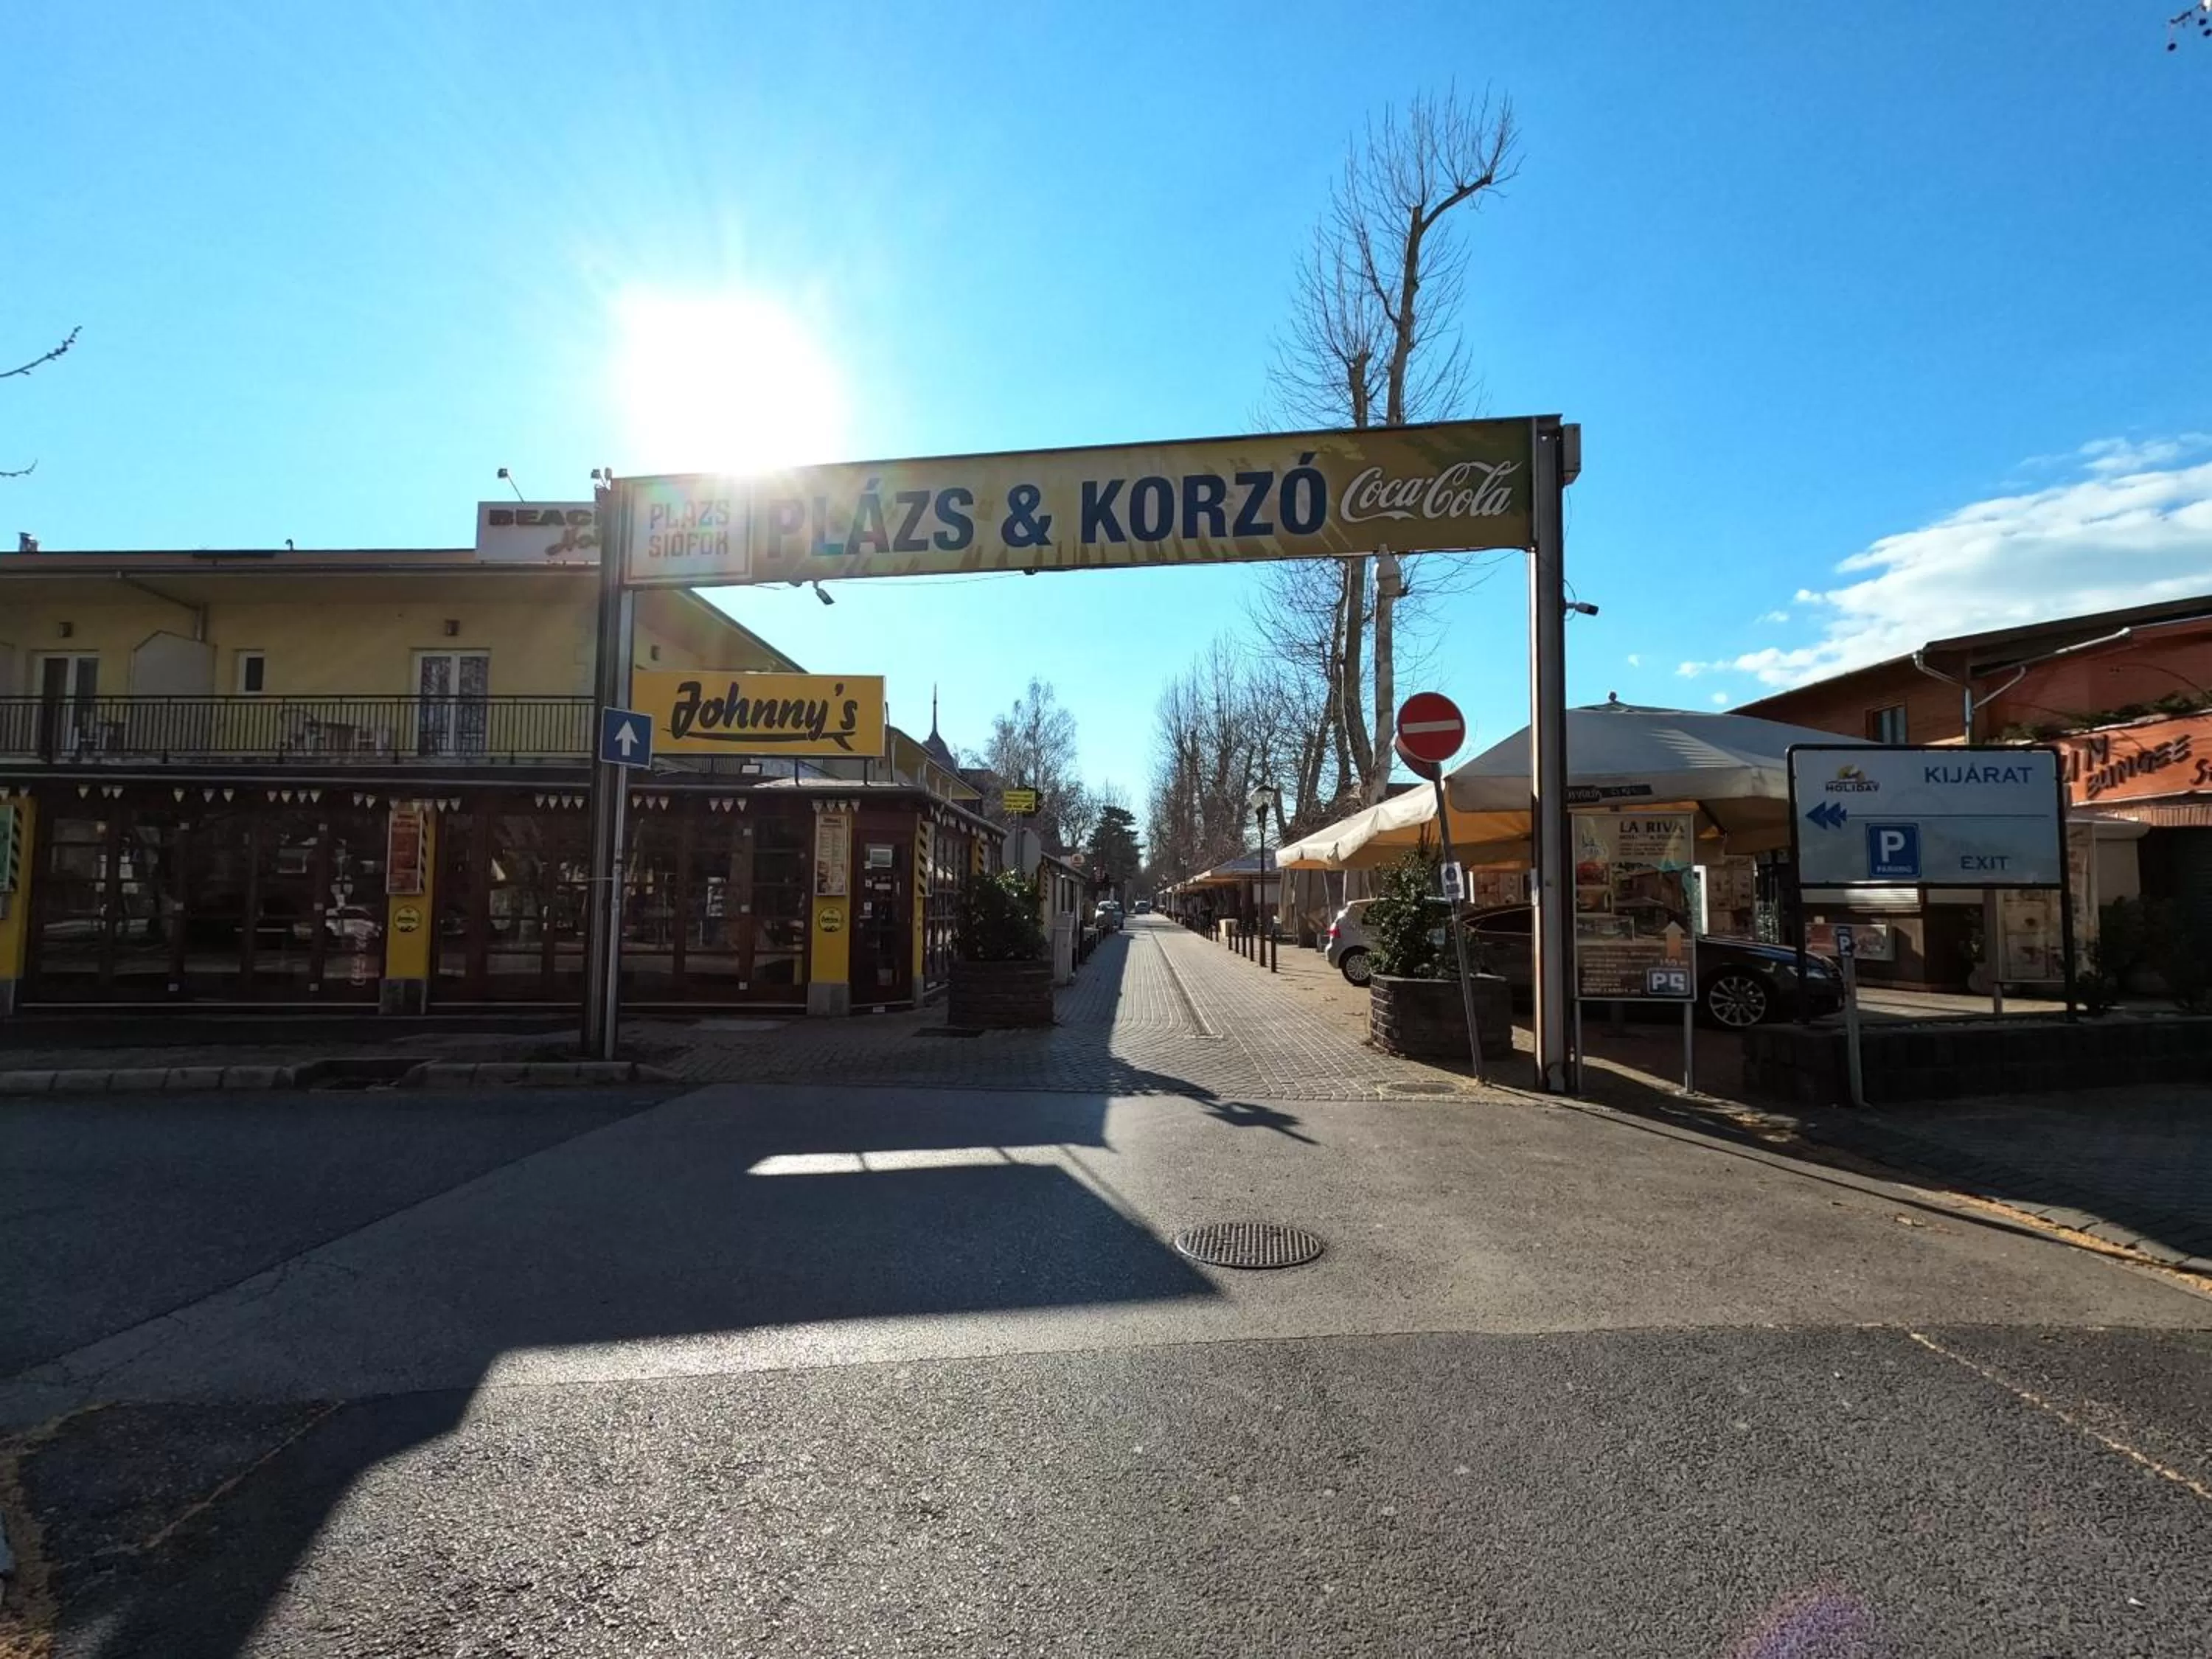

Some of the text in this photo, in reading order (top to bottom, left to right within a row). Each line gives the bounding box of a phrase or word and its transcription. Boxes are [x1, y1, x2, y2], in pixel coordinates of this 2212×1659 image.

[767, 452, 1327, 558] PLÁZS & KORZÓ
[1340, 460, 1523, 523] Coca-Cola
[669, 680, 858, 742] Johnny's
[1924, 762, 2033, 784] KIJÁRAT
[1825, 782, 1880, 793] HOLIDAY
[1619, 821, 1685, 832] LA RIVA
[1880, 830, 1905, 863] P
[1961, 855, 2008, 871] EXIT
